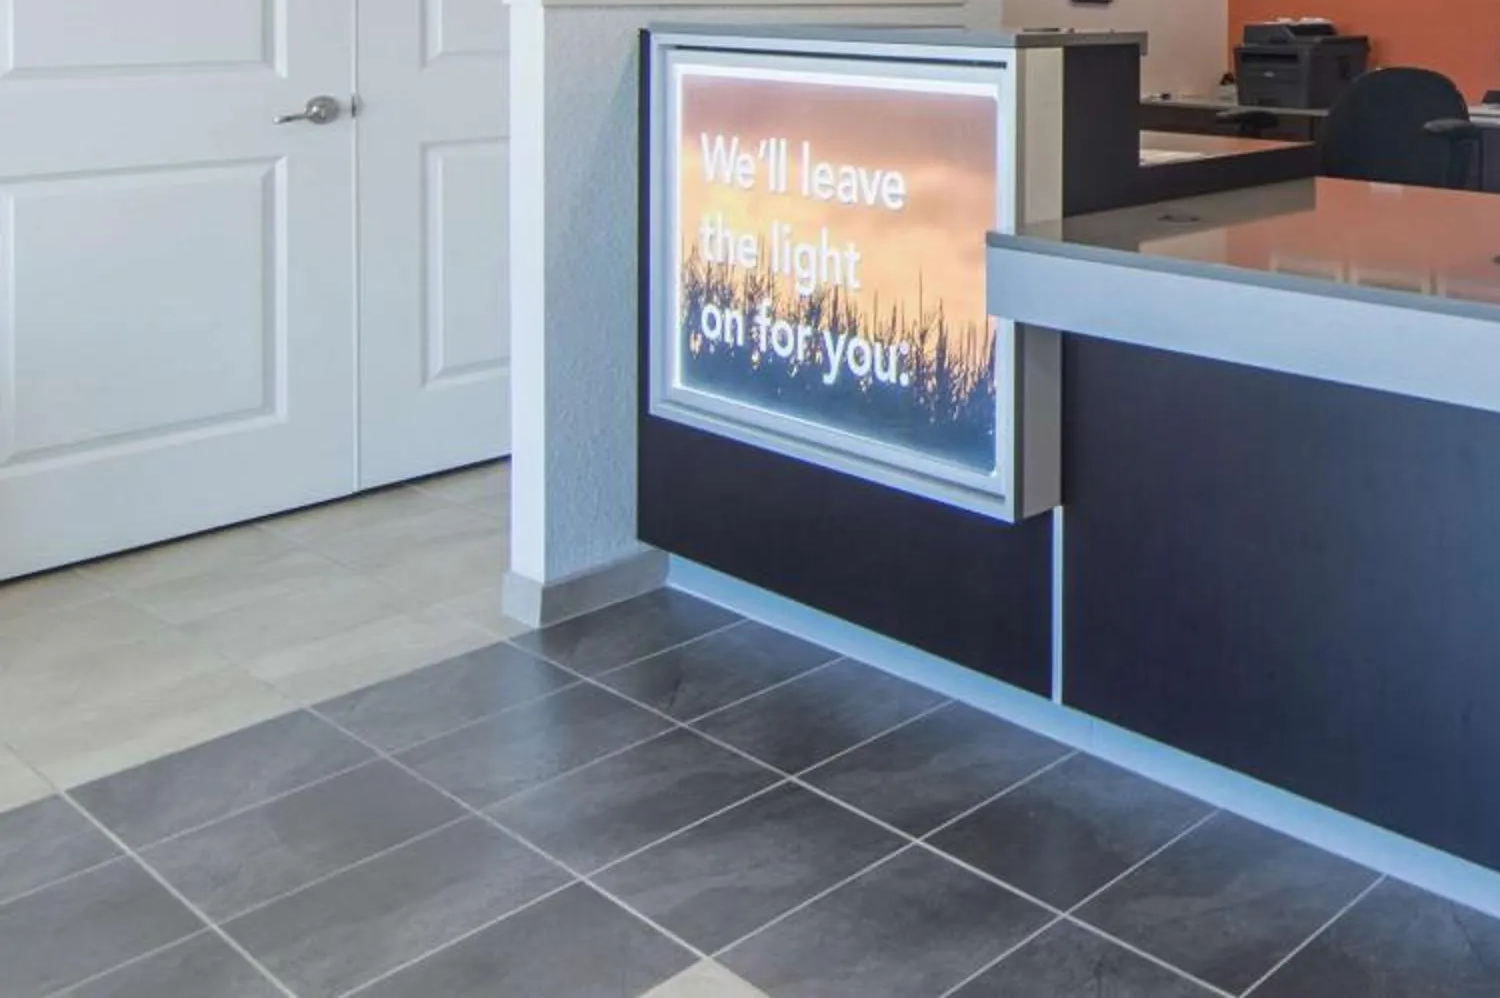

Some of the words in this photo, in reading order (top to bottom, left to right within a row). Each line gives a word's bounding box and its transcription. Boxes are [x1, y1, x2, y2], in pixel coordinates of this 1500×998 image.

[801, 140, 906, 211] leave
[700, 213, 758, 269] the
[771, 219, 861, 295] light
[701, 304, 745, 347] on
[754, 298, 814, 362] for
